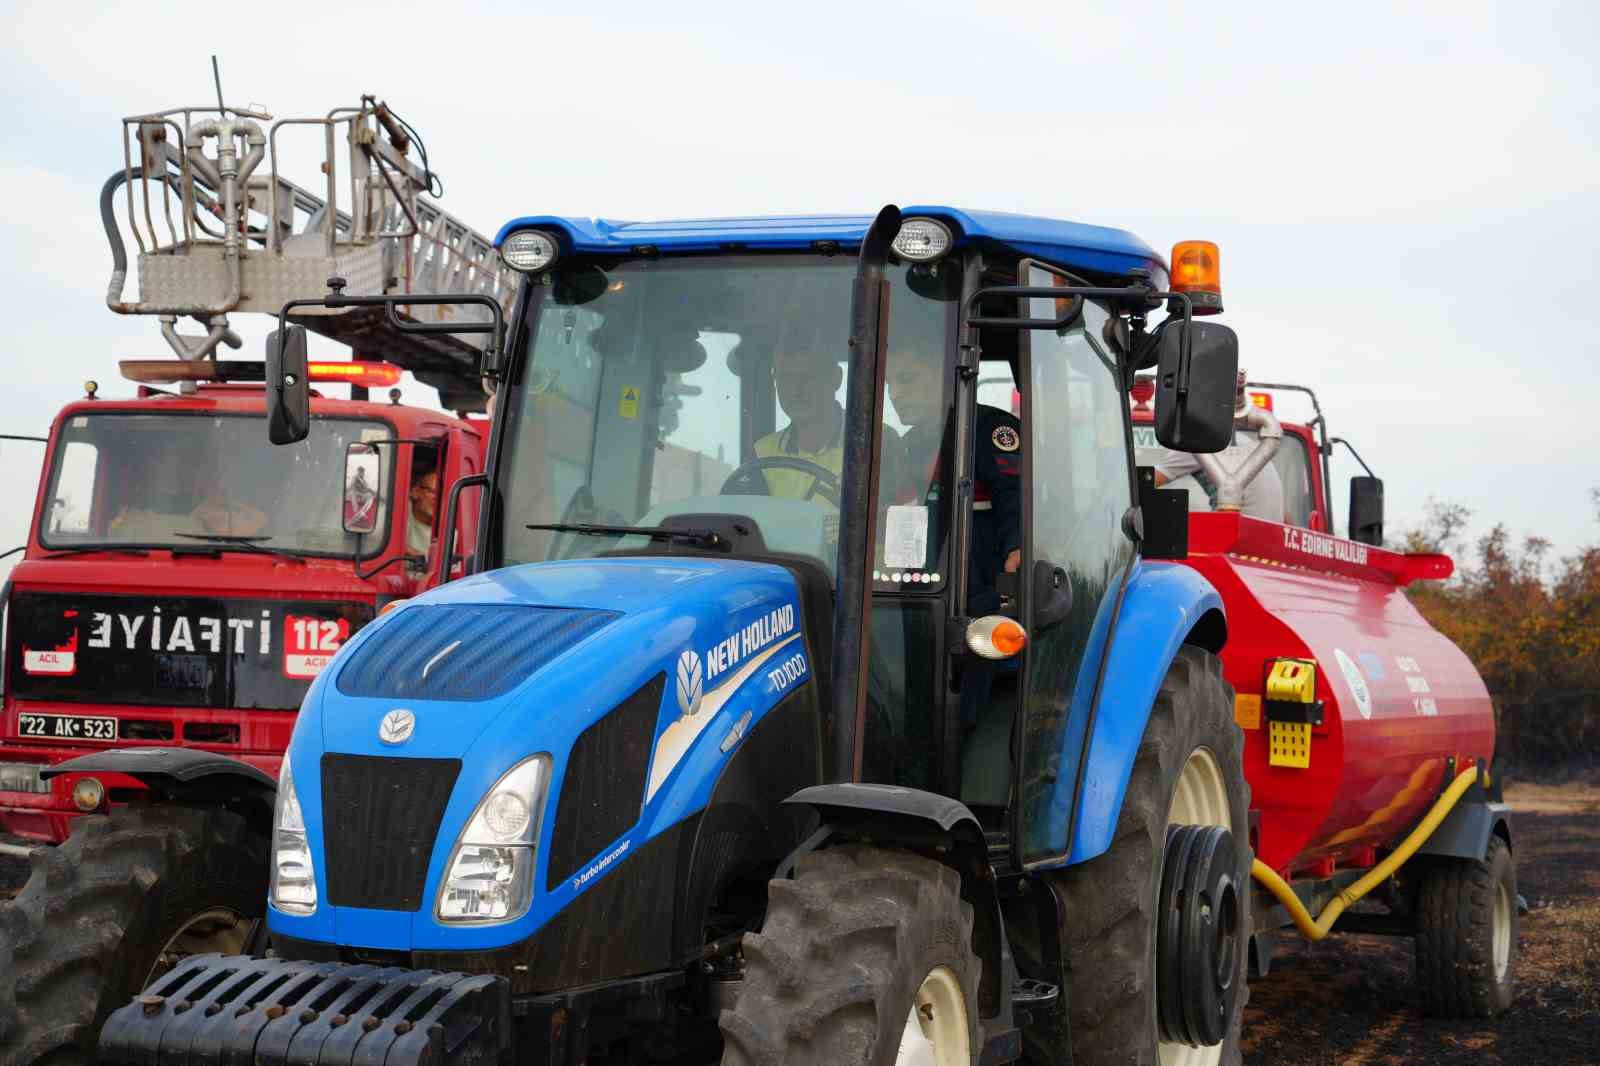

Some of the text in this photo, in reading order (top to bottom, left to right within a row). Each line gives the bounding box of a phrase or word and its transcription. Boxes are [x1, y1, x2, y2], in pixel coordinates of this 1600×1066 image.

[294, 619, 340, 650] 112
[707, 603, 794, 680] NEW HOLLAND
[26, 716, 114, 738] 22 AK 523
